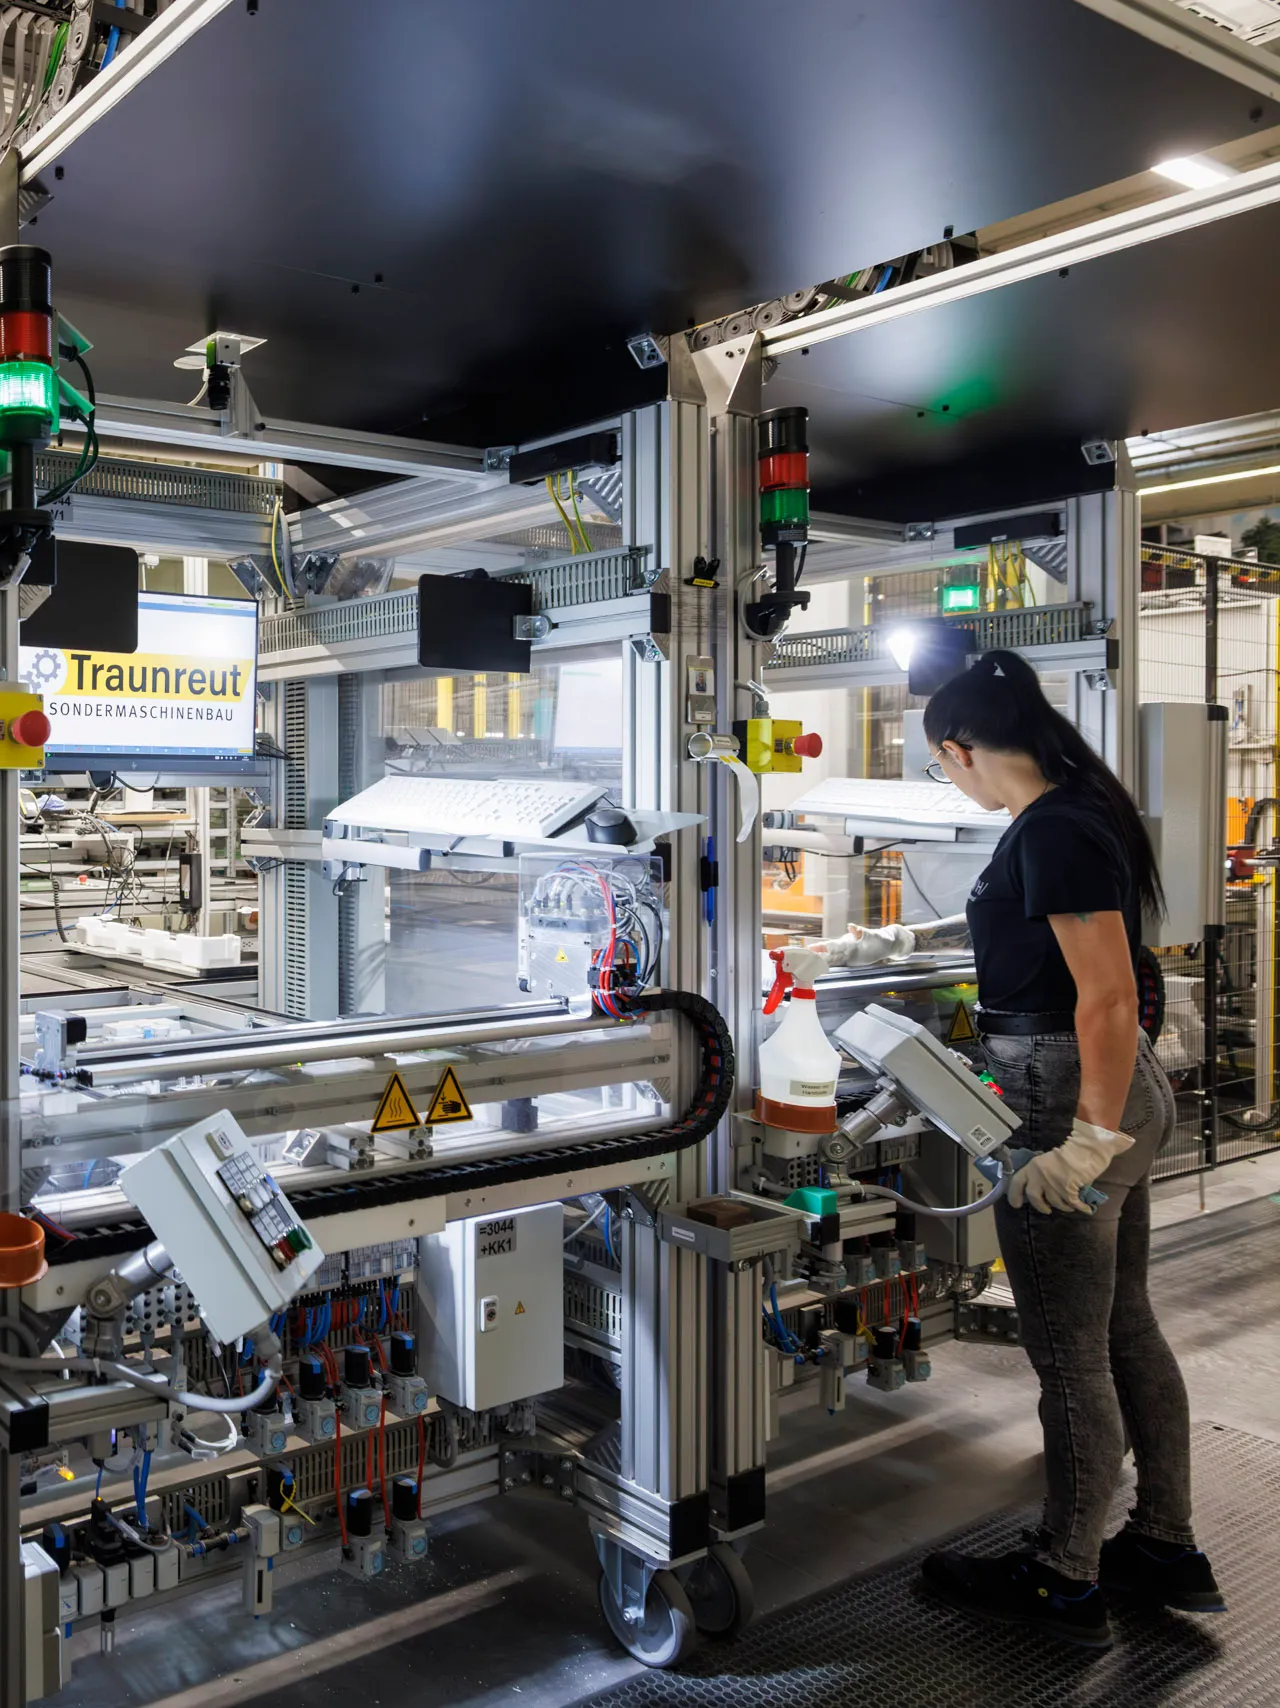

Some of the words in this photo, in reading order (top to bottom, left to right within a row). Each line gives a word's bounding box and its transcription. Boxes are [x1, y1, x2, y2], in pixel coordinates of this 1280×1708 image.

[70, 653, 242, 697] Traunreut
[49, 701, 234, 722] SONDERMASCHINENBAU
[479, 1219, 514, 1236] =3044
[481, 1238, 512, 1256] +KK1
